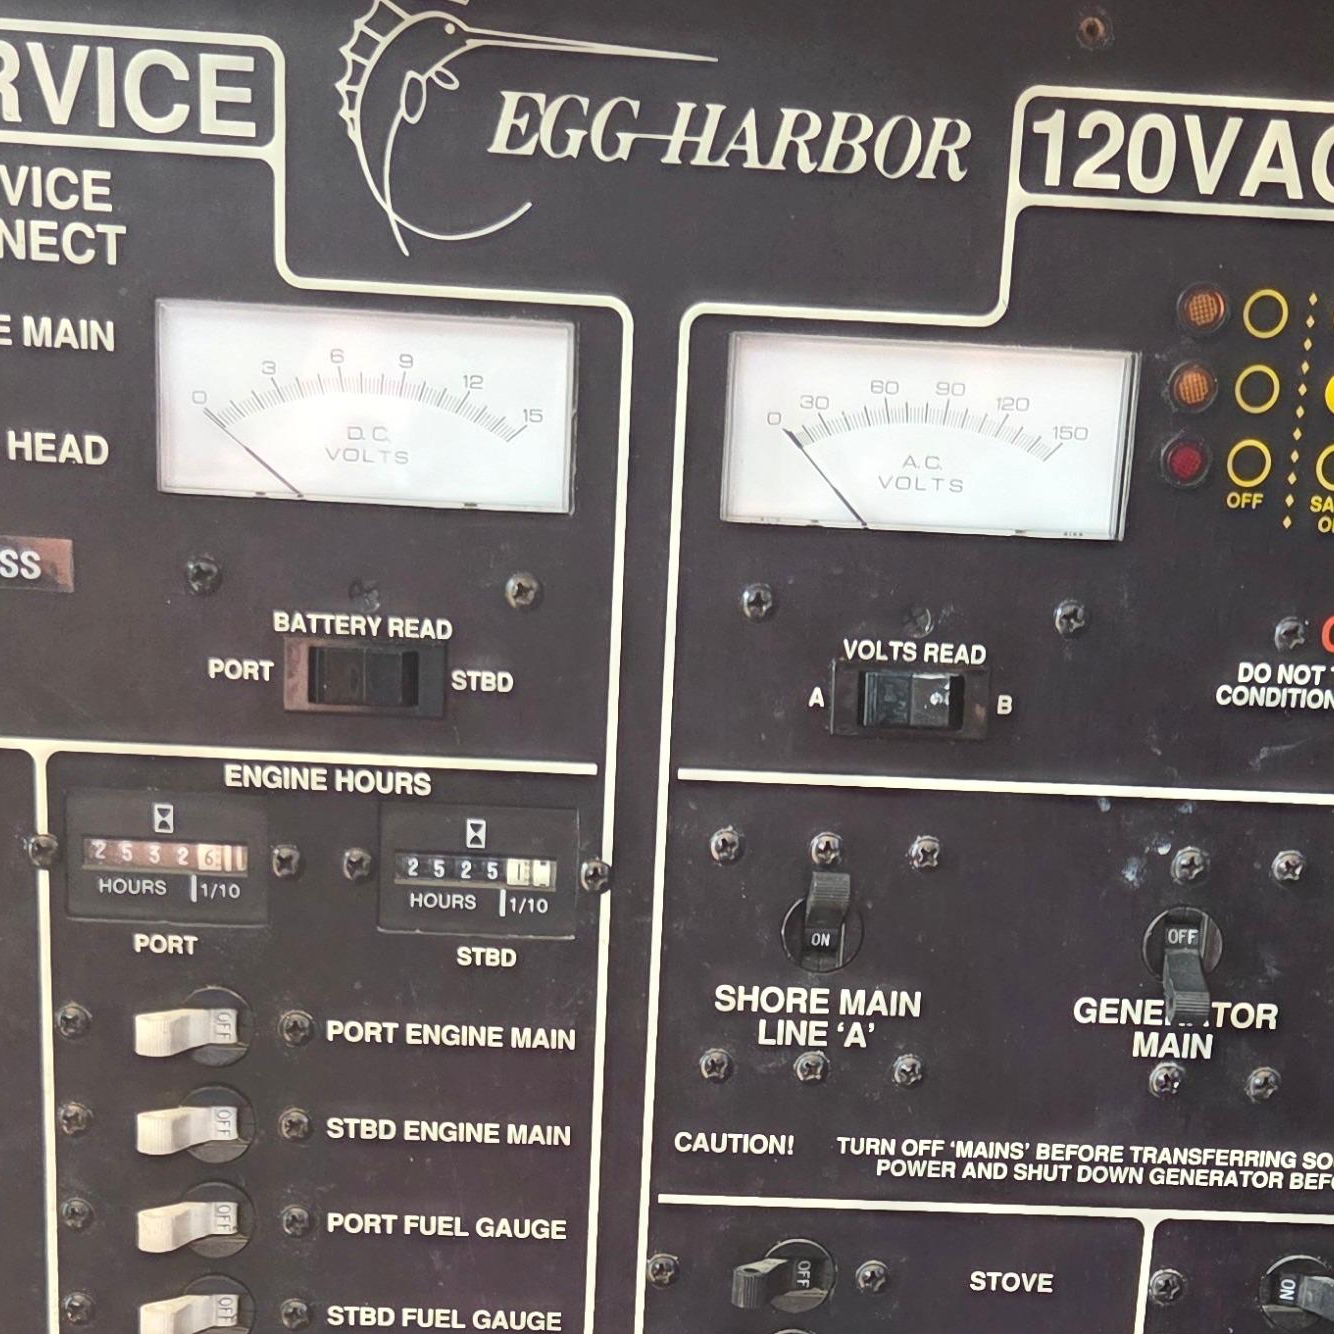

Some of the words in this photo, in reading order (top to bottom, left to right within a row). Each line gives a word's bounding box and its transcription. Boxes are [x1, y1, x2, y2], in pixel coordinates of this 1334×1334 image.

[23, 315, 114, 351] MAIN
[330, 349, 344, 363] 6
[399, 354, 413, 368] 9
[262, 361, 276, 374] 3
[463, 375, 483, 389] 12
[871, 380, 899, 395] 60
[936, 381, 965, 396] 90
[800, 395, 829, 410] 30
[997, 397, 1029, 411] 120
[523, 409, 543, 422] 15
[1053, 426, 1088, 440] 150
[8, 431, 108, 464] HEAD
[326, 448, 408, 464] VOLTS
[878, 476, 963, 493] VOLTS
[1227, 492, 1263, 509] OFF
[274, 612, 381, 636] BATTERY
[388, 617, 452, 639] READ
[844, 639, 916, 661] VOLTS
[924, 643, 986, 664] READ
[209, 658, 274, 681] PORT
[1238, 662, 1271, 683] DO
[1277, 664, 1326, 685] NOT
[452, 670, 513, 692] STBD
[809, 687, 824, 707] A
[997, 695, 1012, 714] B
[225, 764, 327, 790] ENGINE
[336, 769, 431, 795] HOURS
[99, 878, 166, 895] HOURS
[201, 884, 240, 898] 1/10
[812, 933, 830, 946] ON
[715, 985, 829, 1014] SHORE
[840, 989, 921, 1017] MAIN
[327, 1020, 399, 1043] PORT
[406, 1023, 503, 1047] ENGINE
[511, 1027, 575, 1050] MAIN
[758, 1019, 828, 1046] LINE
[675, 1132, 794, 1155] CAUTION!
[837, 1137, 896, 1155] TURN
[901, 1139, 945, 1157] OFF
[1036, 1143, 1124, 1163] BEFORE
[1130, 1146, 1296, 1168] TRANSFERRING
[877, 1159, 956, 1178] POWER
[962, 1162, 1007, 1179] AND
[1014, 1163, 1072, 1181] SHUT
[1077, 1165, 1143, 1184] DOWN
[1149, 1168, 1284, 1188] GENERATOR
[970, 1271, 1053, 1292] STOVE
